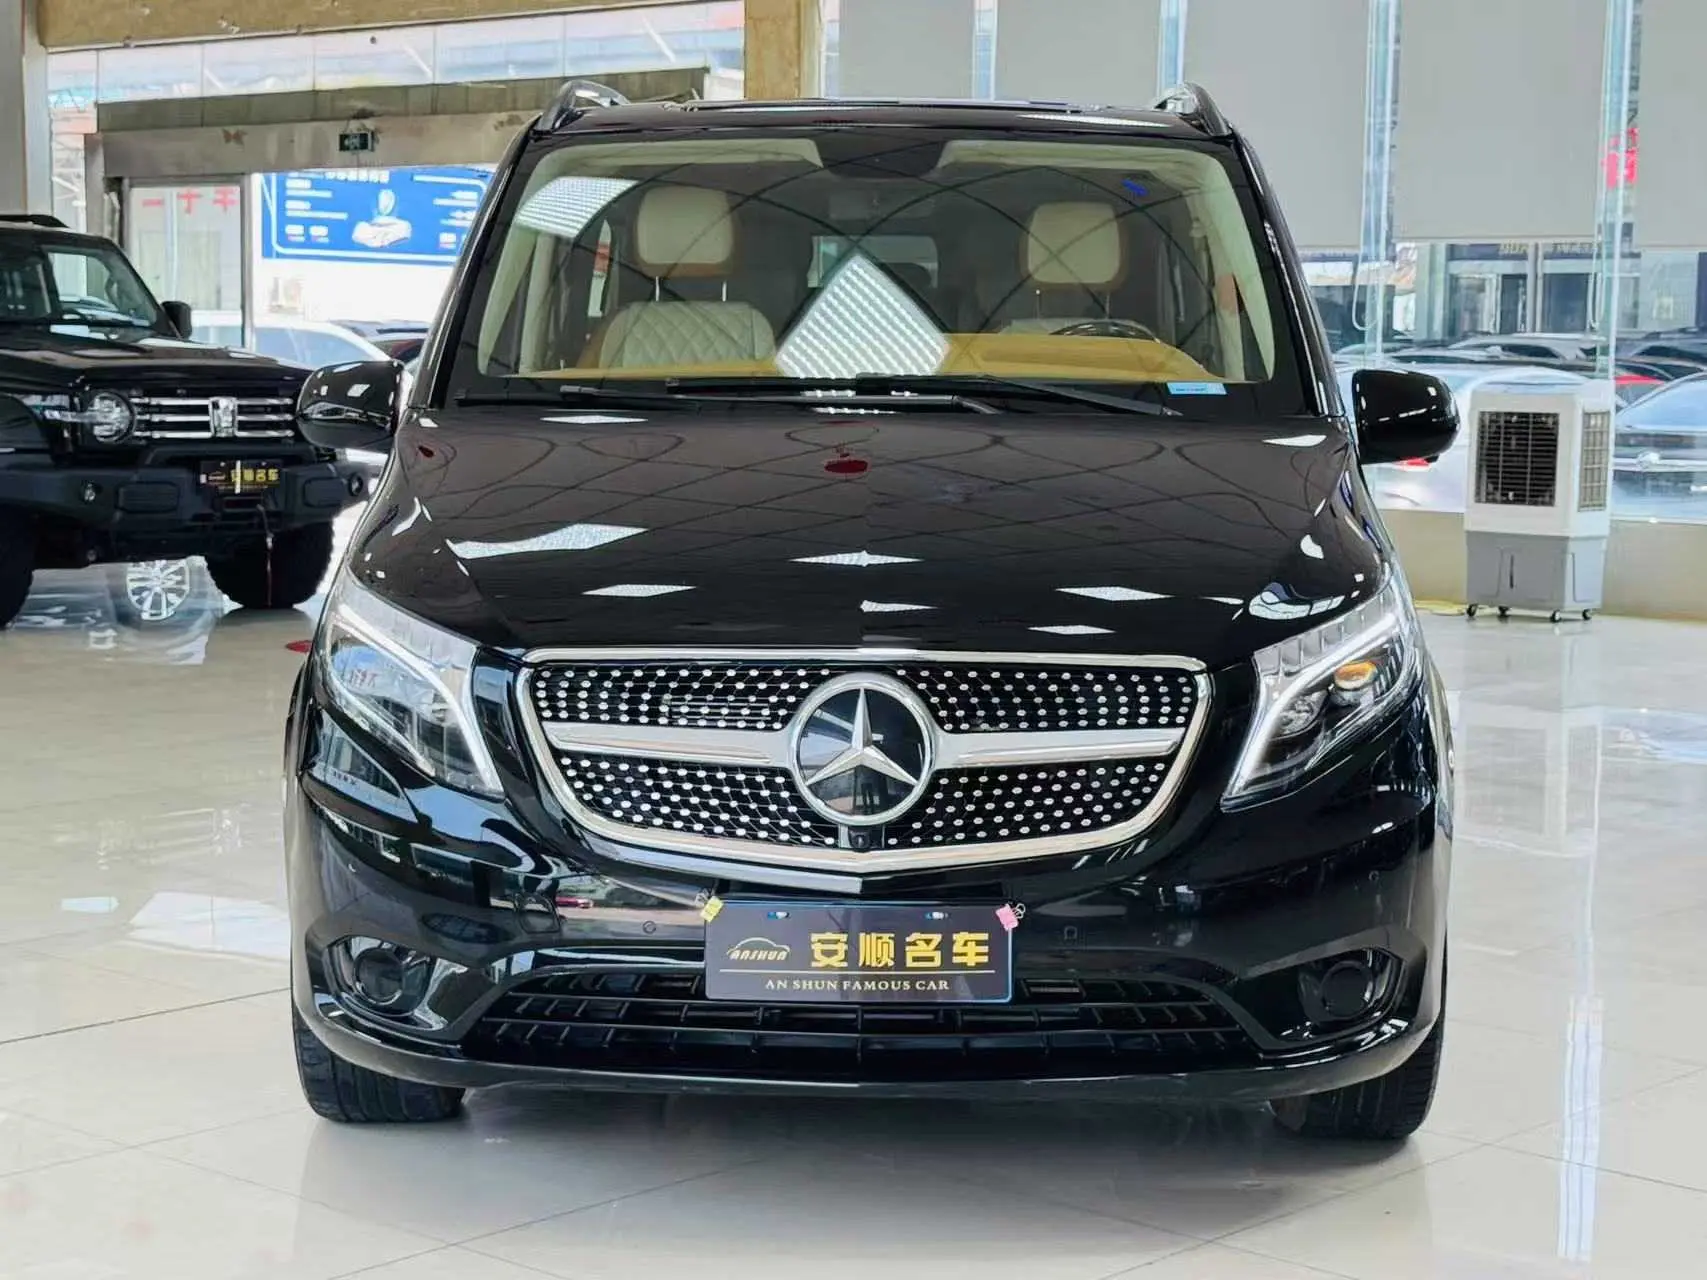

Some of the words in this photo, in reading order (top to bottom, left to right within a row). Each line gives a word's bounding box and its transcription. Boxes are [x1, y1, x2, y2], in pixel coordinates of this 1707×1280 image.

[810, 931, 989, 968] 安顺名车
[765, 979, 788, 990] AN
[792, 979, 838, 991] SHUN
[843, 980, 911, 991] FAMOUS
[915, 980, 950, 991] CAR
